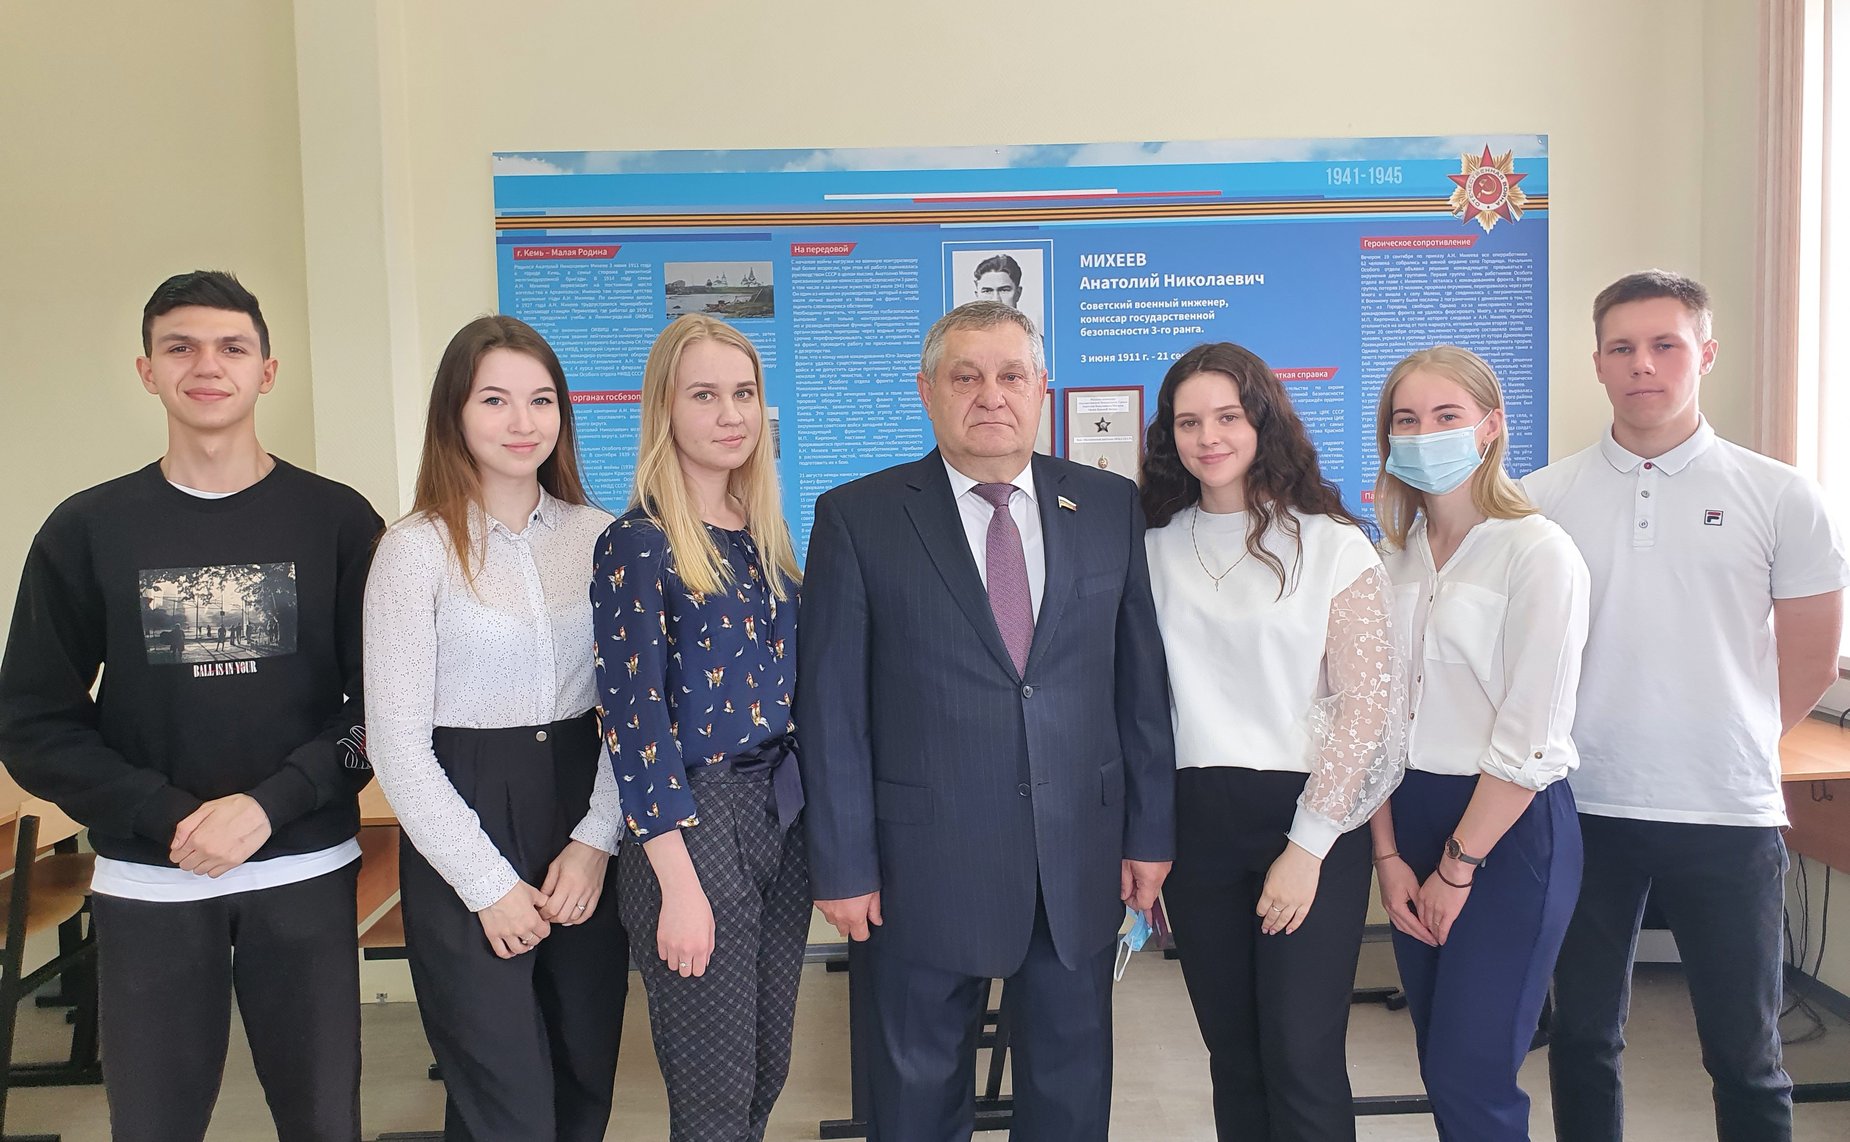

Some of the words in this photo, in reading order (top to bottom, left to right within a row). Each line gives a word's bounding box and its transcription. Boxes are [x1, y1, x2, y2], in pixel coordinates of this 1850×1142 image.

[1326, 166, 1402, 185] 1941-1945
[1364, 240, 1412, 248] Героическое
[1413, 238, 1471, 247] сопротивление
[578, 249, 607, 257] Родина
[806, 245, 848, 255] передовой
[1080, 253, 1147, 268] МИХЕЕВ
[1080, 274, 1160, 290] Анатолий
[1164, 274, 1265, 288] Николаевич
[1080, 300, 1132, 310] Советский
[1135, 299, 1179, 309] военный
[1181, 299, 1228, 309] инженер,
[1080, 315, 1127, 324] комиссар
[1129, 311, 1215, 323] государственной
[1080, 327, 1149, 337] безопасности
[1151, 326, 1170, 335] 3-го
[1173, 326, 1204, 335] ранга.
[1081, 354, 1086, 363] 3
[1118, 353, 1140, 362] 1911
[1157, 352, 1168, 360] 21
[606, 392, 641, 400] госбезоп
[193, 664, 214, 677] BALL
[215, 663, 224, 675] IS
[225, 662, 234, 675] IN
[235, 660, 257, 674] YOUR
